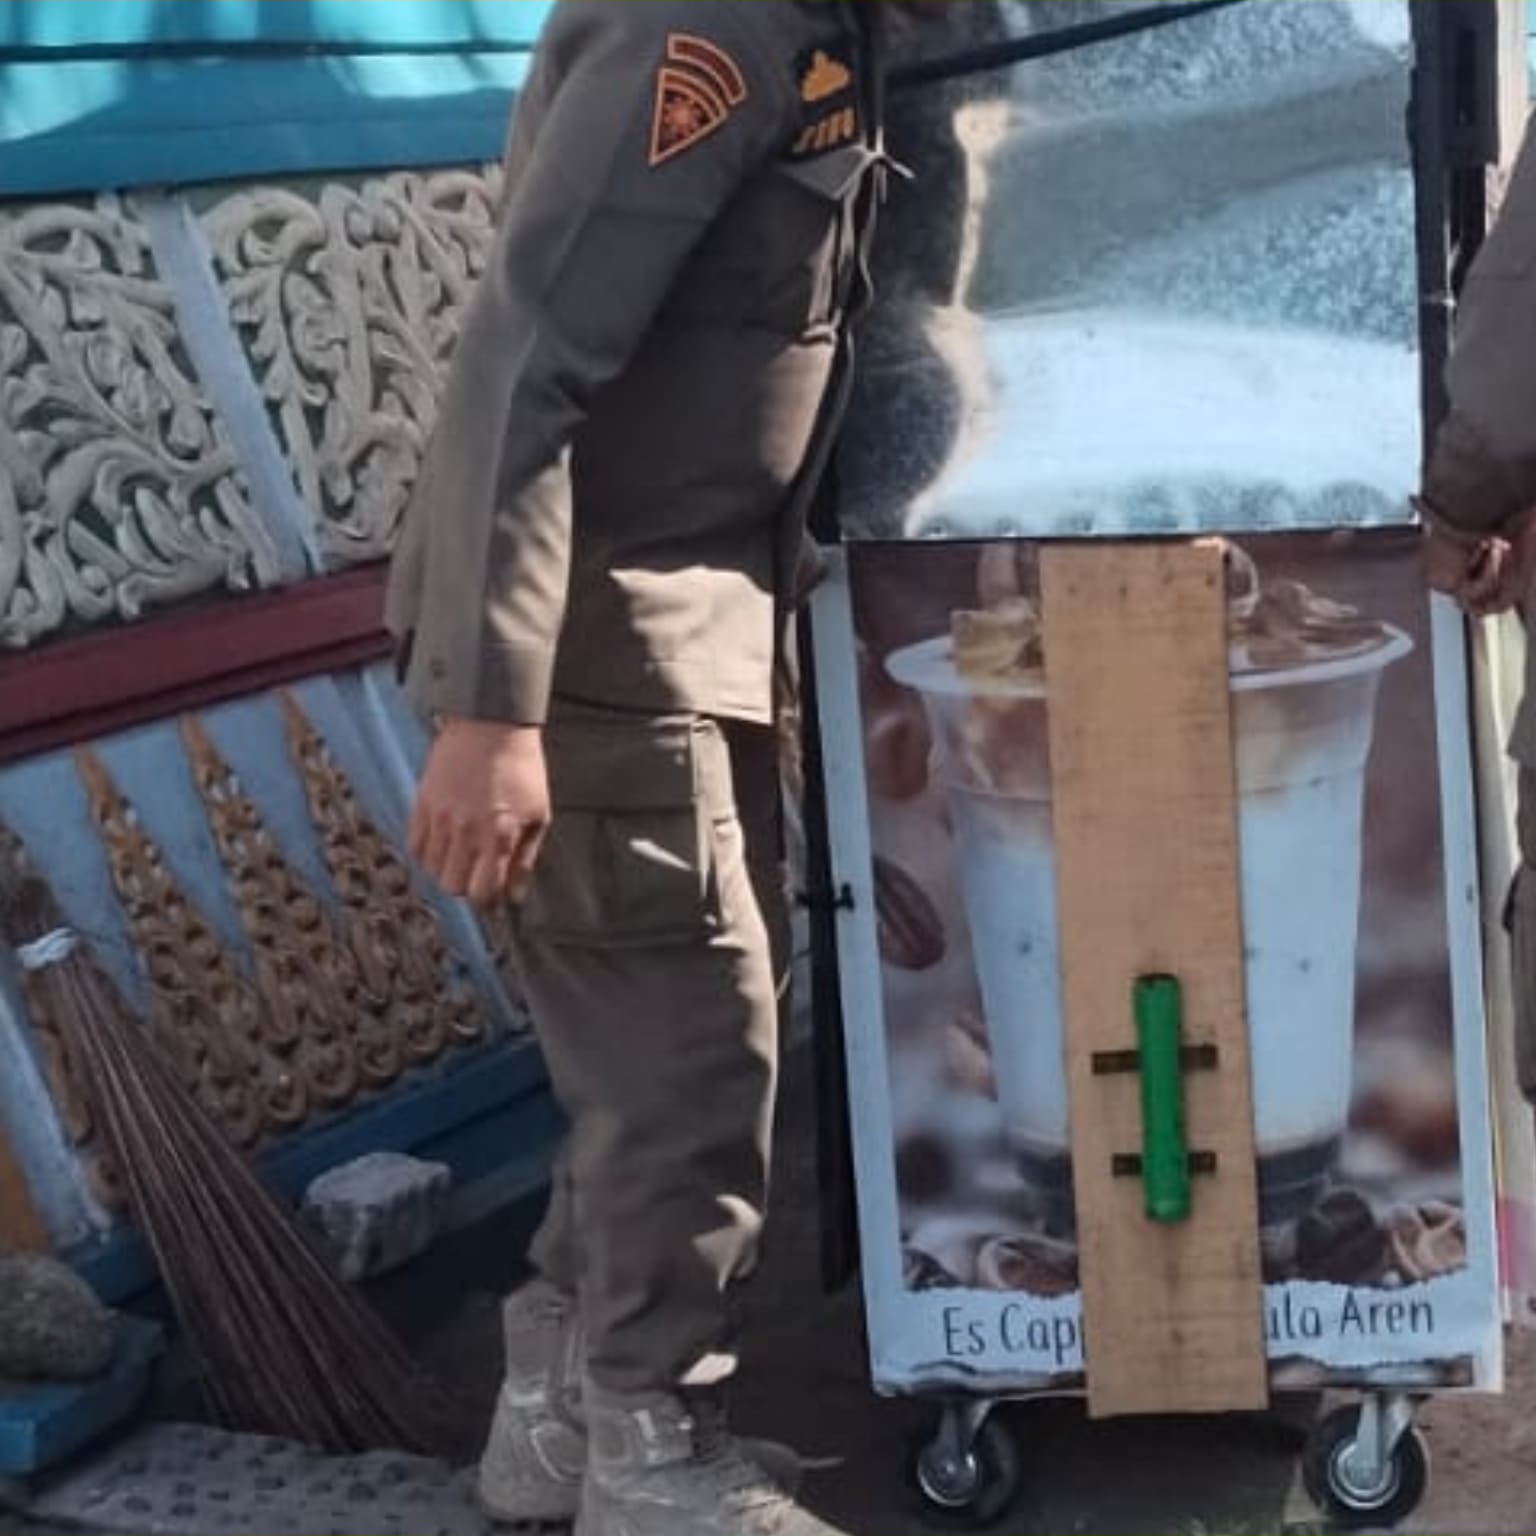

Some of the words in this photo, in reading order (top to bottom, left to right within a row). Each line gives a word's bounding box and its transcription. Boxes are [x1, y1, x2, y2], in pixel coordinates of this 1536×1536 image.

[943, 1306, 985, 1356] Es
[1000, 1302, 1087, 1365] Cap
[1340, 1290, 1434, 1336] Aren
